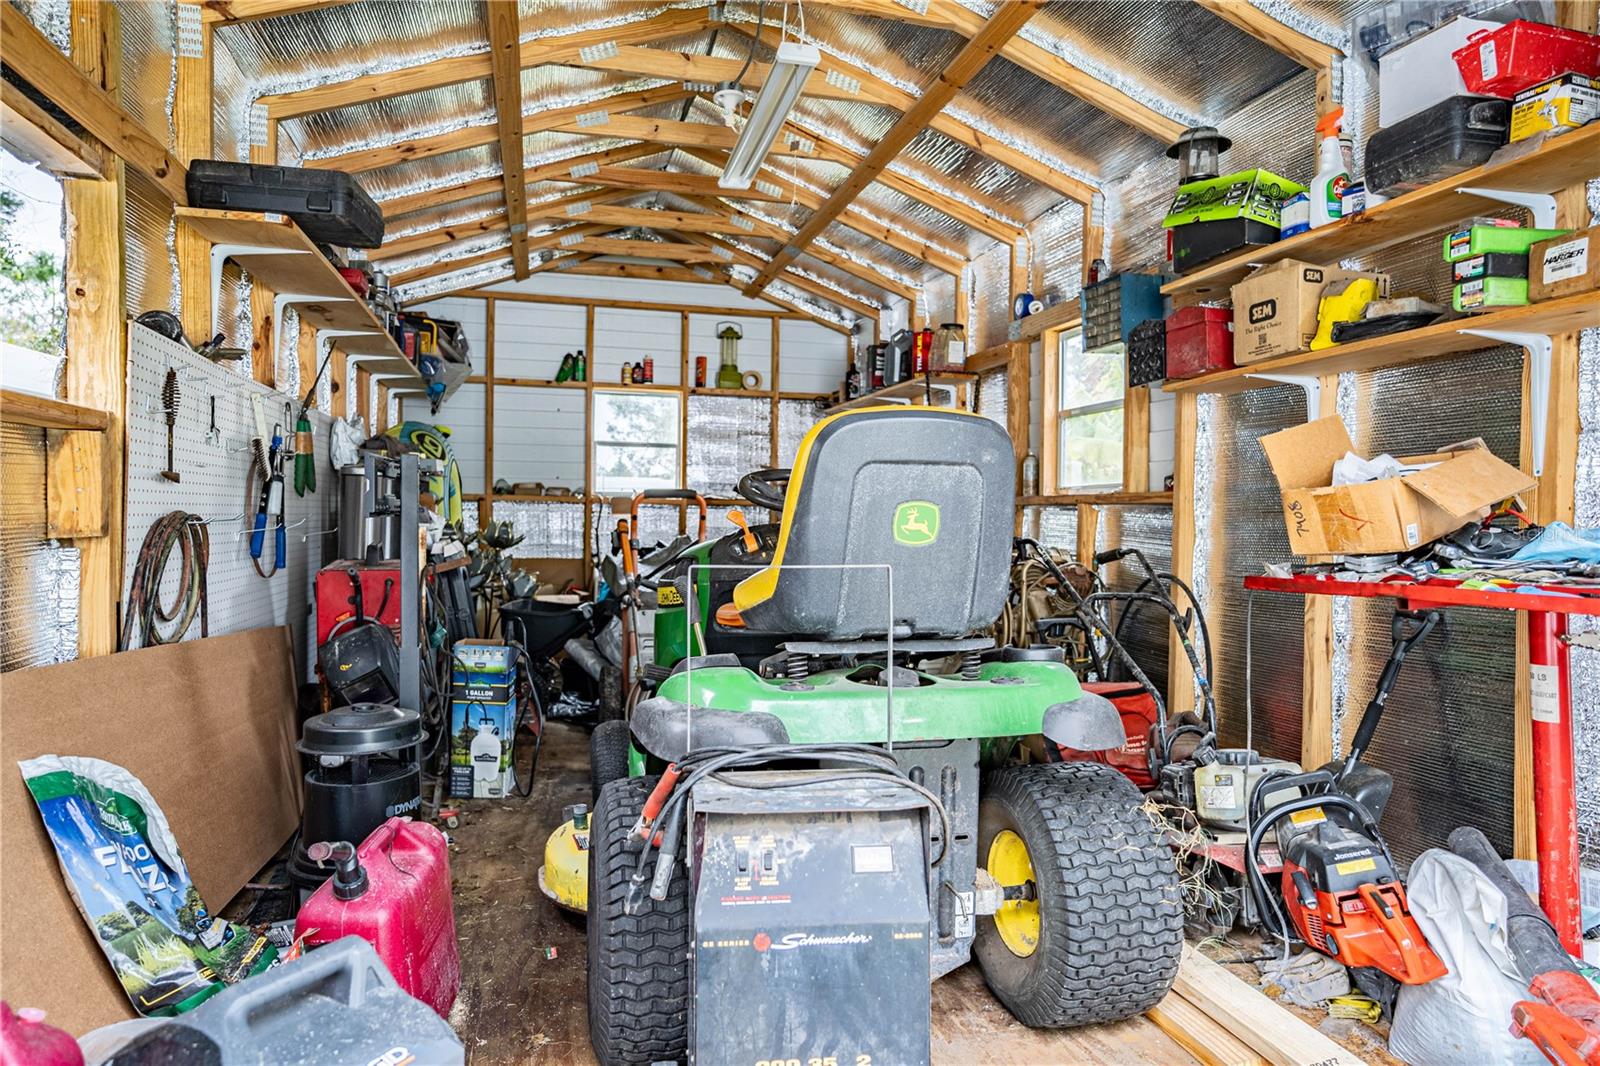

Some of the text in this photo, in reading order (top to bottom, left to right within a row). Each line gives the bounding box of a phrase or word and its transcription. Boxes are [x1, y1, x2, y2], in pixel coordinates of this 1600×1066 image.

[1305, 270, 1321, 282] SEM
[1252, 303, 1273, 320] SEM
[1334, 848, 1372, 861] Jonsered
[770, 931, 871, 950] Schumacher
